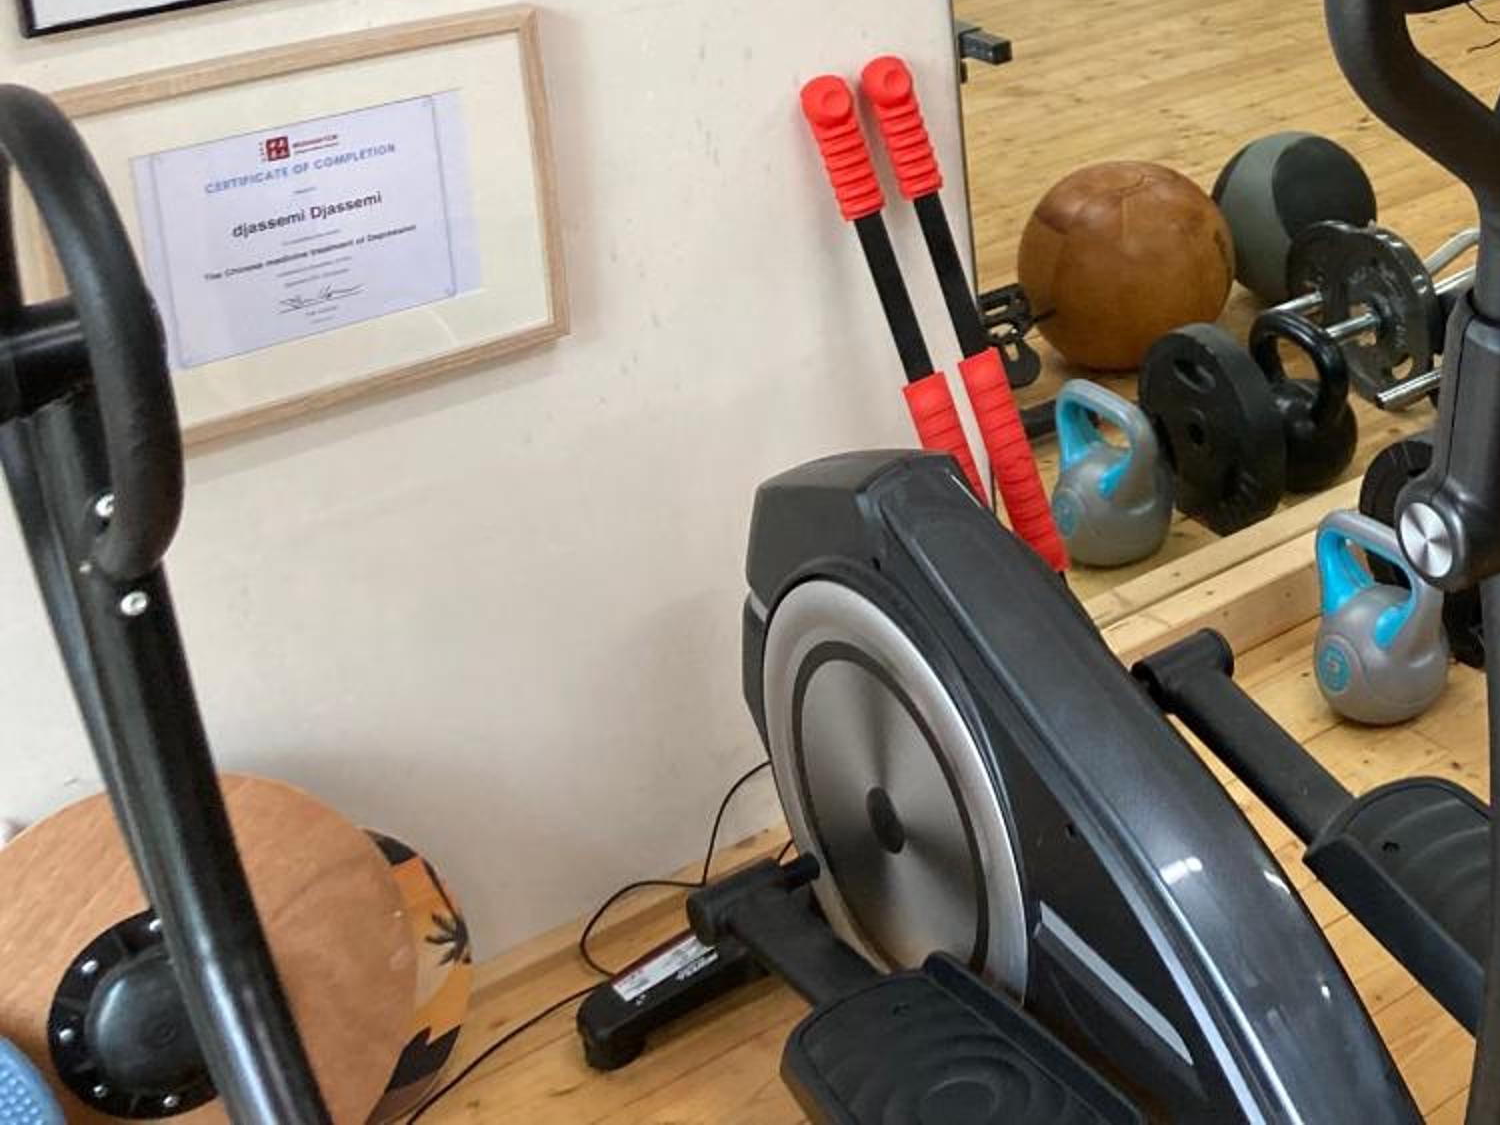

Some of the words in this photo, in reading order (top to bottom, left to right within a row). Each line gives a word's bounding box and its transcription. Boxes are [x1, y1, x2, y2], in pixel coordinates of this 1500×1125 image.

[204, 166, 290, 195] CERTIFICATE
[292, 162, 312, 176] OF
[314, 144, 397, 171] COMPLETION
[232, 209, 307, 239] djassemi
[309, 191, 383, 221] Djassemi
